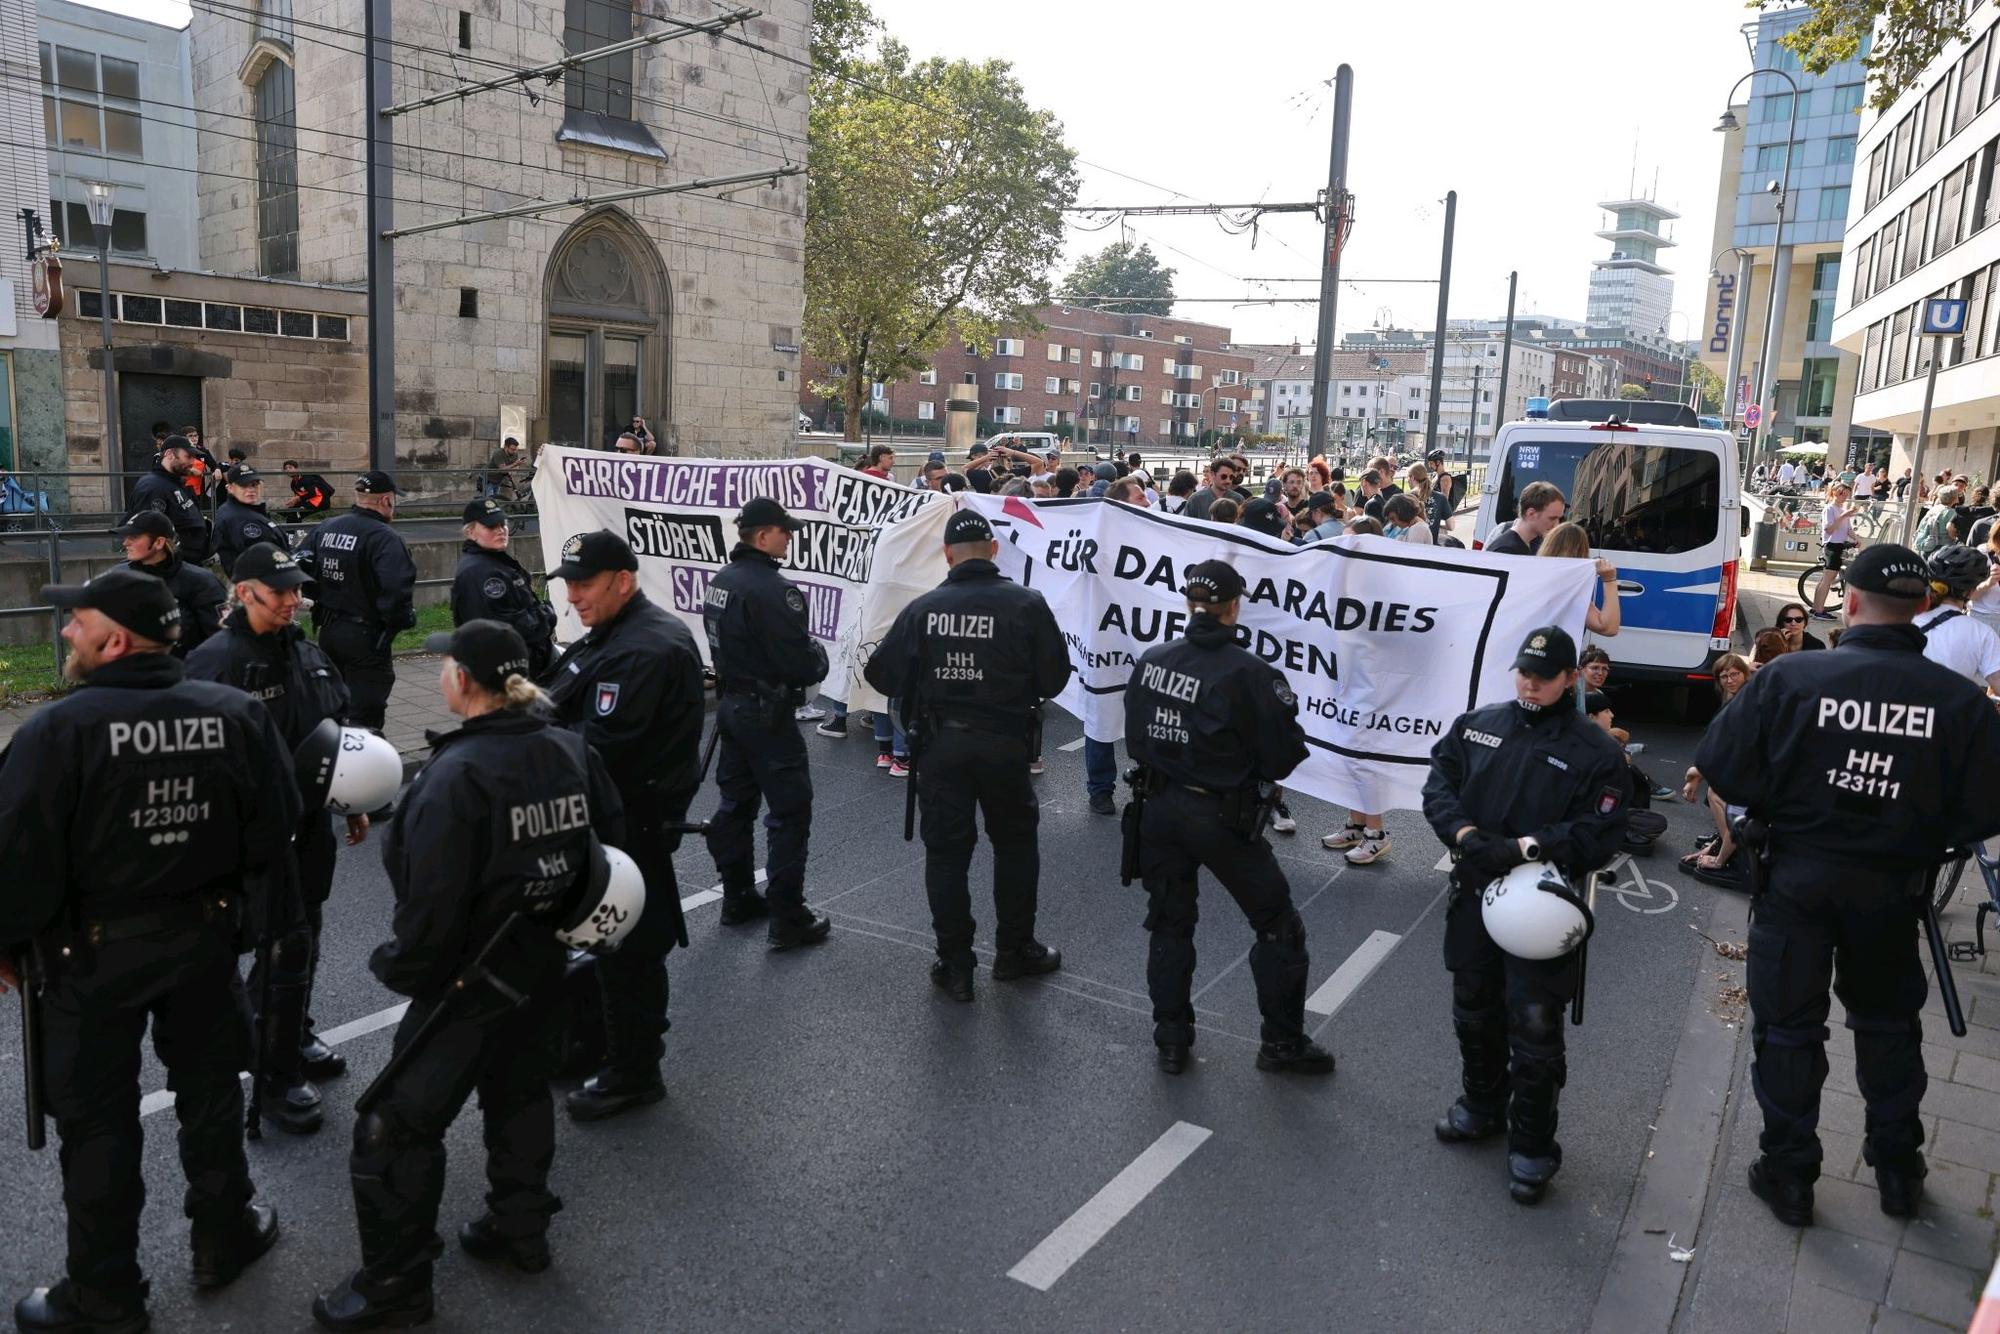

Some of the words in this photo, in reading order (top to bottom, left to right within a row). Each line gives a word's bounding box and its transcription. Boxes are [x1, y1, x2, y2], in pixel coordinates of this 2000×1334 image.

[1710, 274, 1735, 352] Dorint
[1931, 304, 1961, 329] U
[1519, 445, 1540, 453] NRW
[564, 458, 719, 507] CHRISTLICHE
[724, 465, 807, 508] FUNDIS
[813, 468, 830, 511] &
[628, 514, 728, 564] STÖREN,
[955, 518, 986, 532] POLIZEI
[320, 532, 358, 551] POLIZEI
[1045, 529, 1099, 574] FÜR
[322, 557, 340, 570] HH
[1239, 577, 1440, 633] ARADIES
[926, 612, 994, 639] POLIZEI
[946, 651, 975, 667] HH
[1233, 623, 1339, 682] RDEN
[933, 667, 984, 681] 123394
[1141, 662, 1201, 703] POLIZEI
[1154, 705, 1182, 728] HH
[1306, 695, 1360, 727] HÖLLE
[1366, 712, 1442, 736] JAGEN
[1817, 697, 1935, 739] POLIZEI
[108, 716, 225, 757] POLIZEI
[342, 732, 366, 752] 23
[1146, 723, 1189, 744] 123179
[1462, 727, 1503, 749] POLIZEI
[1845, 748, 1894, 777] HH
[147, 776, 194, 805] HH
[1825, 767, 1901, 800] 123111
[129, 801, 210, 829] 123001
[511, 793, 590, 841] POLIZEI
[538, 849, 569, 878] HH
